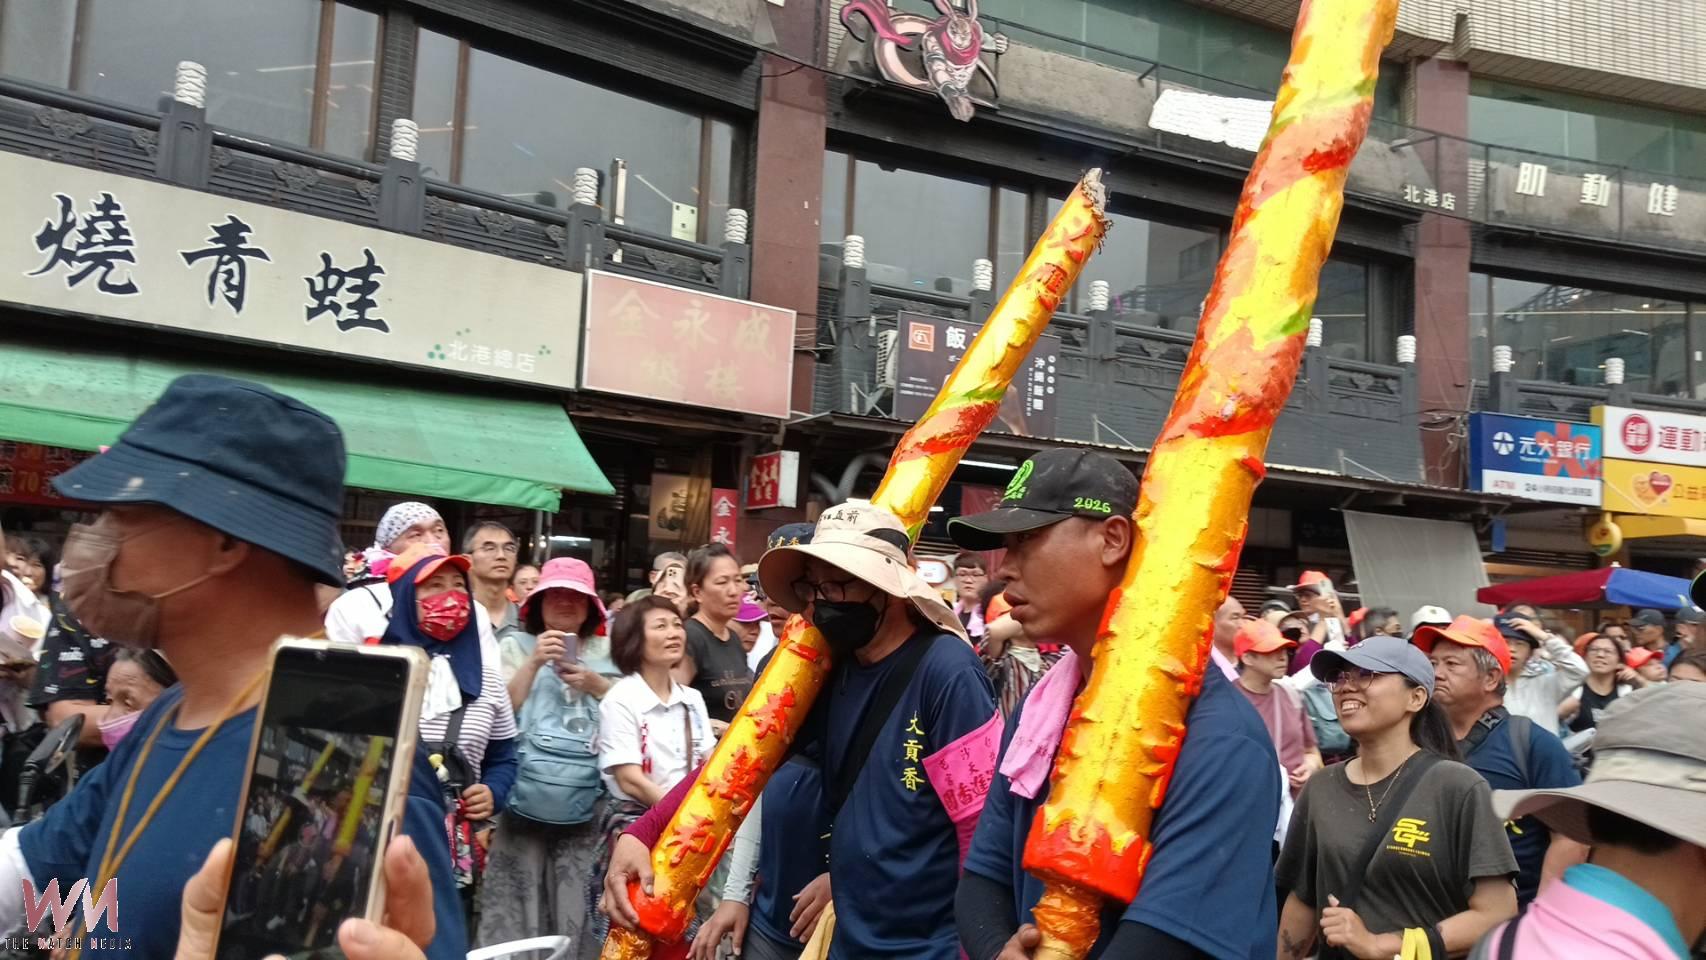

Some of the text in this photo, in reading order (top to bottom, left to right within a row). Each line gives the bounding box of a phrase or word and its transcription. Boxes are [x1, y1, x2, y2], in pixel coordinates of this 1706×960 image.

[1403, 184, 1457, 211] 北港店
[25, 192, 390, 334] 燒青蛙
[945, 326, 978, 350] 飯
[448, 340, 536, 373] 北港總店
[1519, 437, 1592, 460] 元大銀行
[1657, 425, 1706, 452] 運動
[712, 496, 736, 545] 金永
[900, 710, 925, 791] 大貢香
